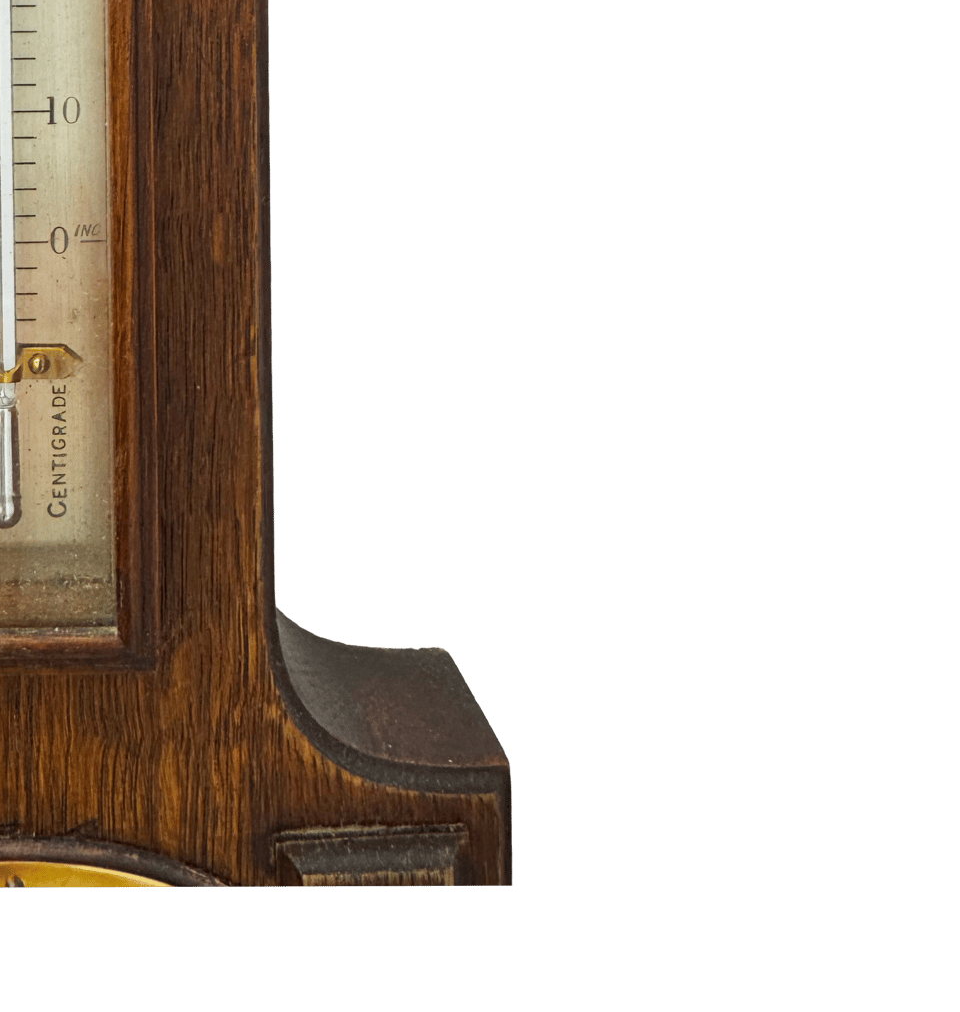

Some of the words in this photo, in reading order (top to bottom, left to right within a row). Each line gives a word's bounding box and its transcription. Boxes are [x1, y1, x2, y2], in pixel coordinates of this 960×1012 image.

[46, 96, 81, 125] 10
[50, 226, 69, 255] 0
[47, 384, 68, 518] CENTIGRADE
